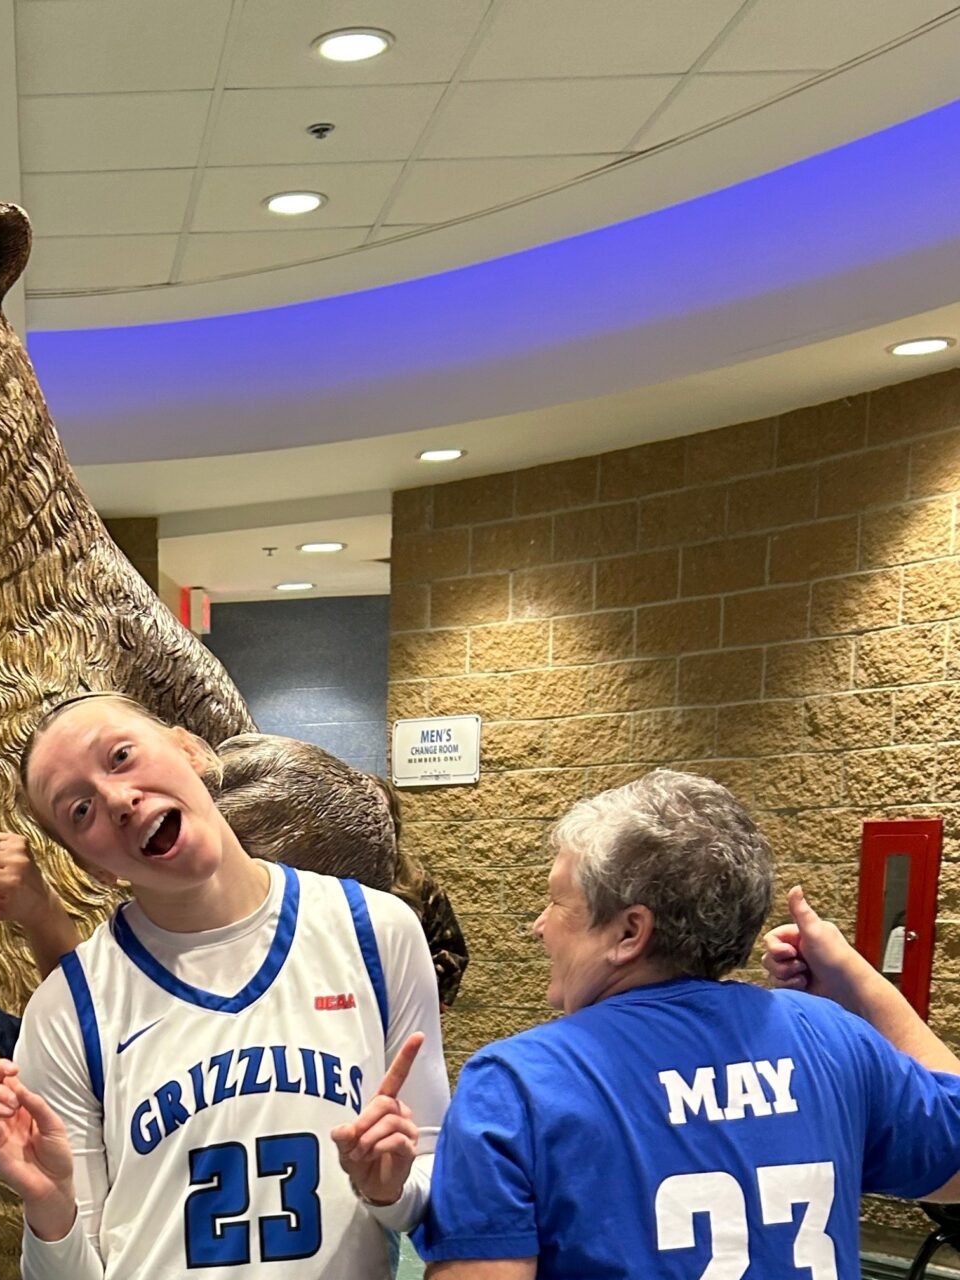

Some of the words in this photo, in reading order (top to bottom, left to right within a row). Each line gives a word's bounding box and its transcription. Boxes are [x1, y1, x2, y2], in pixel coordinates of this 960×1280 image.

[410, 746, 438, 756] CHANGE
[438, 744, 459, 754] ROOM
[420, 728, 452, 743] MEN'S
[407, 756, 441, 764] MEMBERS
[129, 1045, 364, 1156] GRIZZLIES
[658, 1057, 799, 1125] MAY
[183, 1132, 323, 1270] 23
